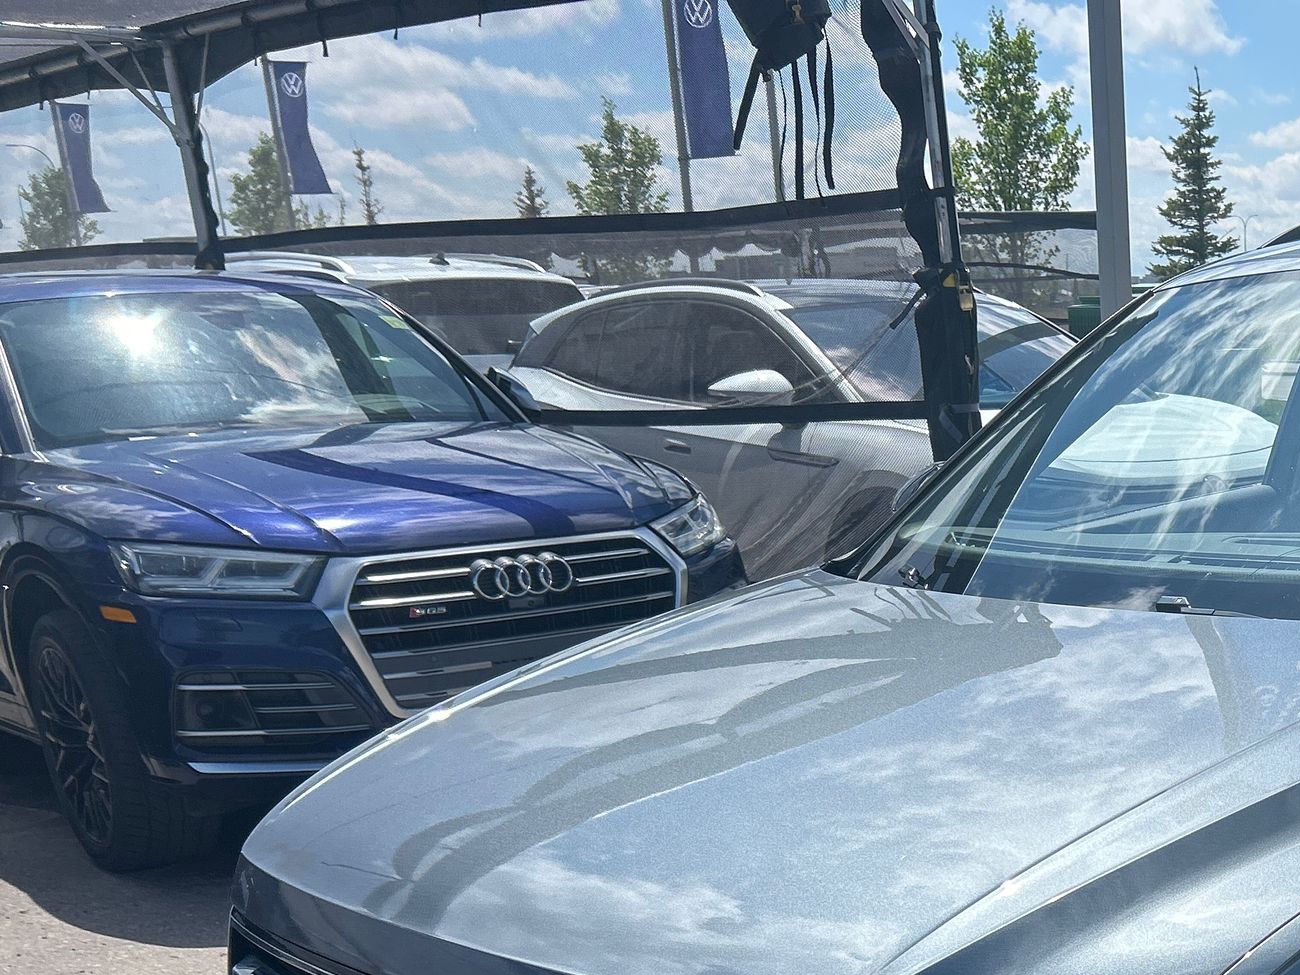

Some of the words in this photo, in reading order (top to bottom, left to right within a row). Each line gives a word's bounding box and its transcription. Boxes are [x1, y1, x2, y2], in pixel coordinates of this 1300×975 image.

[684, 0, 713, 29] VW
[282, 72, 303, 97] VW
[68, 112, 85, 134] VW
